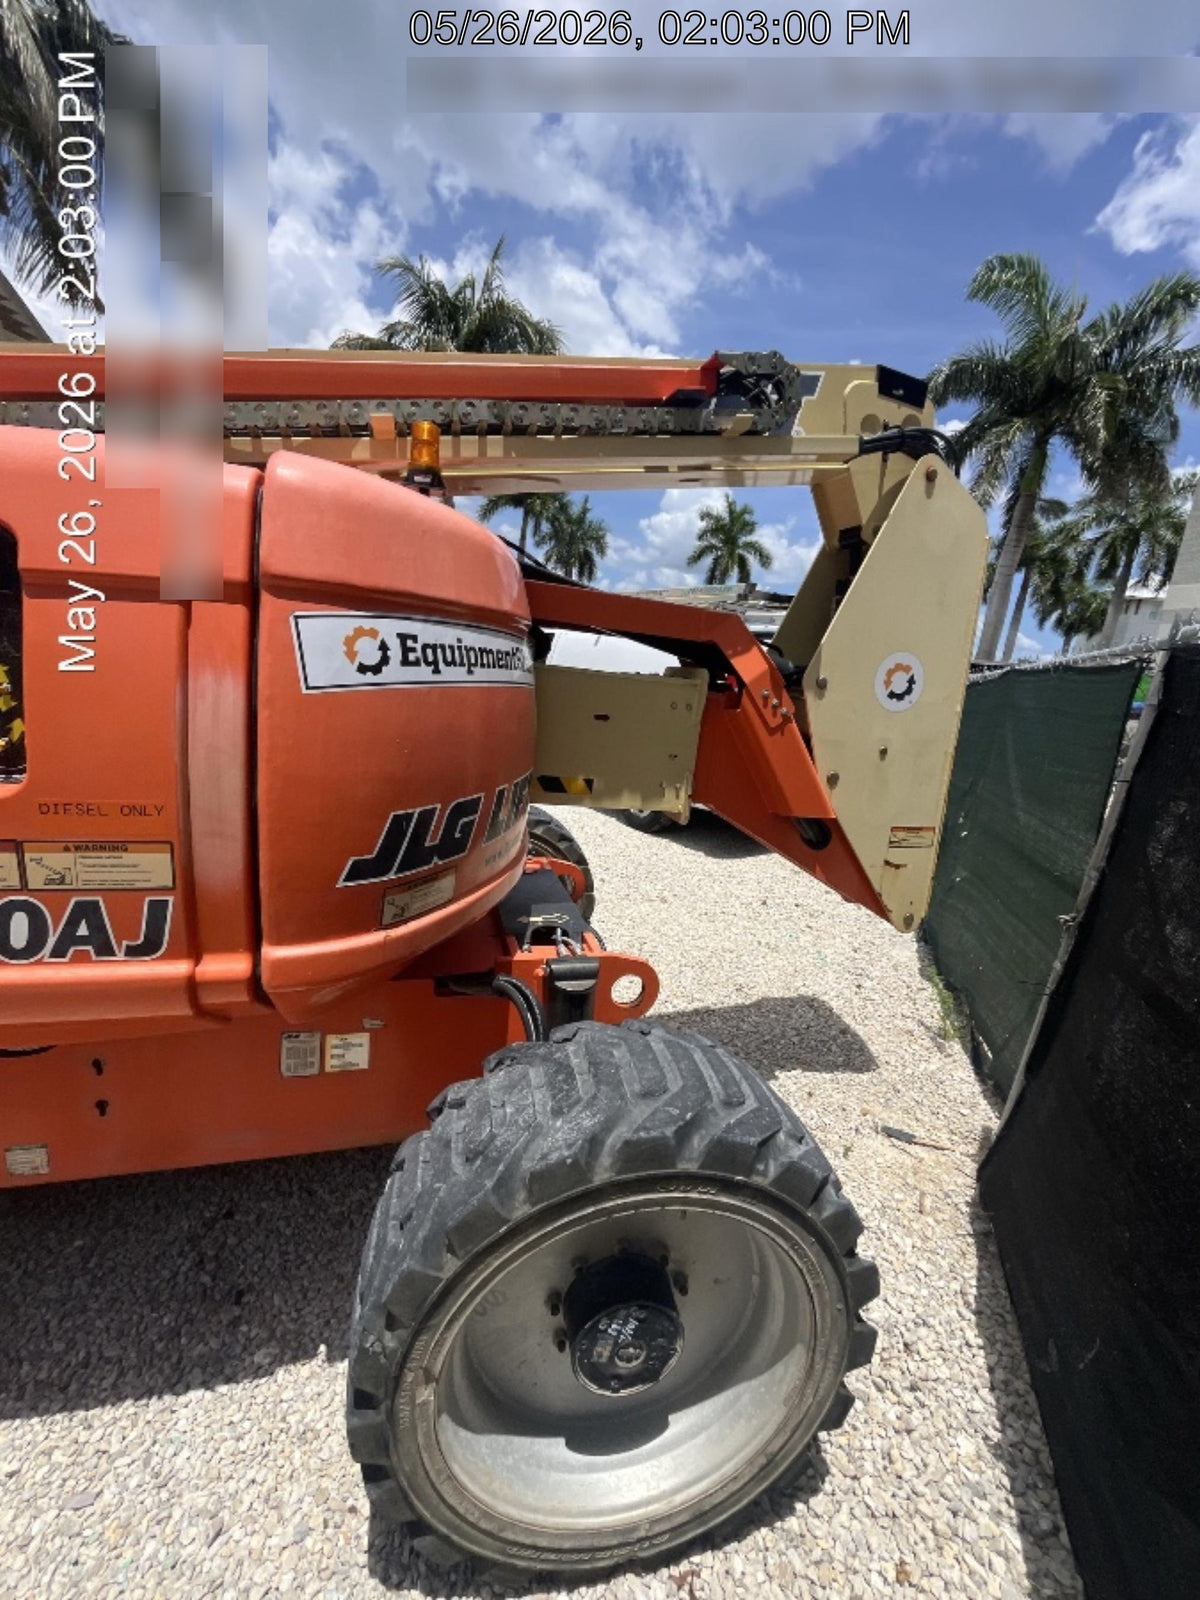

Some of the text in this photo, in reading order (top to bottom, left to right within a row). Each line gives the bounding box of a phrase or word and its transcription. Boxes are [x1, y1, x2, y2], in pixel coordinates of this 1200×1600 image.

[38, 803, 164, 817] DIESEL ONLY
[336, 793, 485, 887] JLG
[73, 844, 129, 852] WARNING
